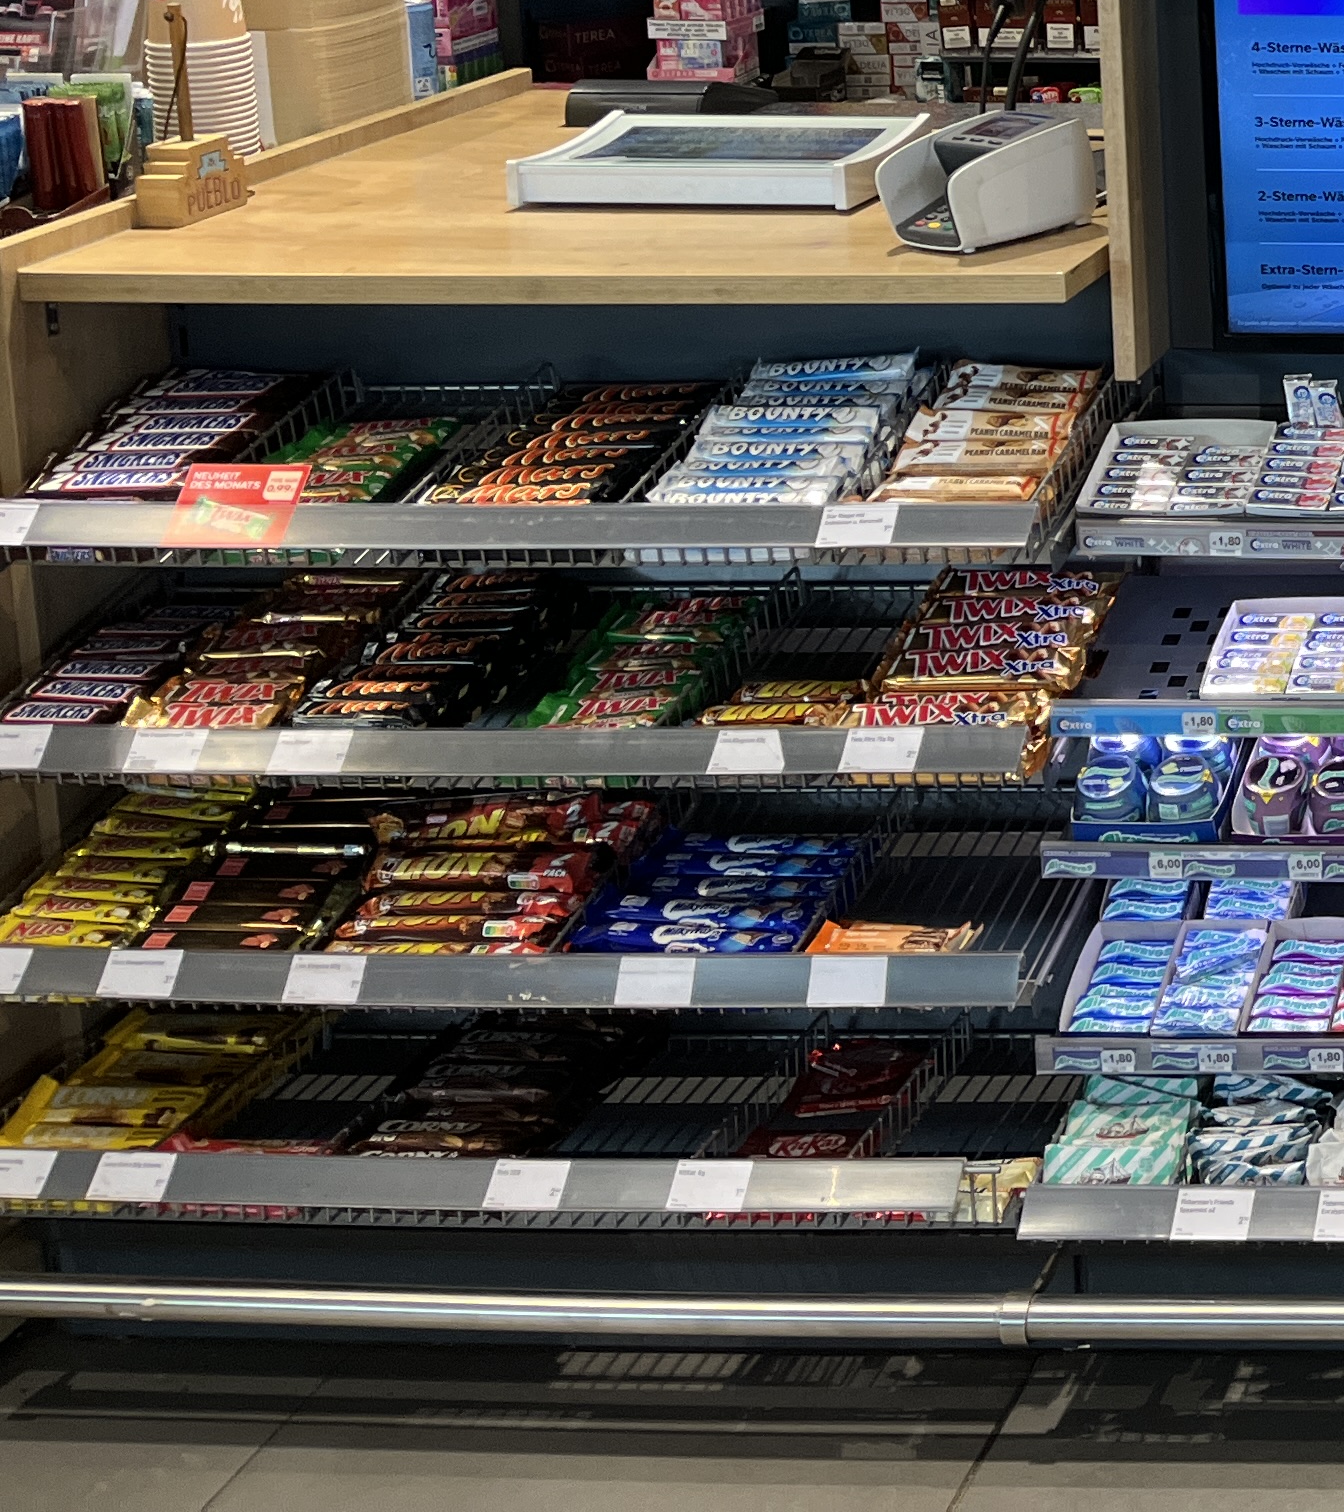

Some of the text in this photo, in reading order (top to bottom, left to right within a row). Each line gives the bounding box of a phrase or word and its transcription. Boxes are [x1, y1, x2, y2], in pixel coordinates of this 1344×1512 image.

[188, 177, 241, 215] PUEBLO
[193, 472, 242, 480] NEUHEIT
[214, 481, 261, 489] MONATS
